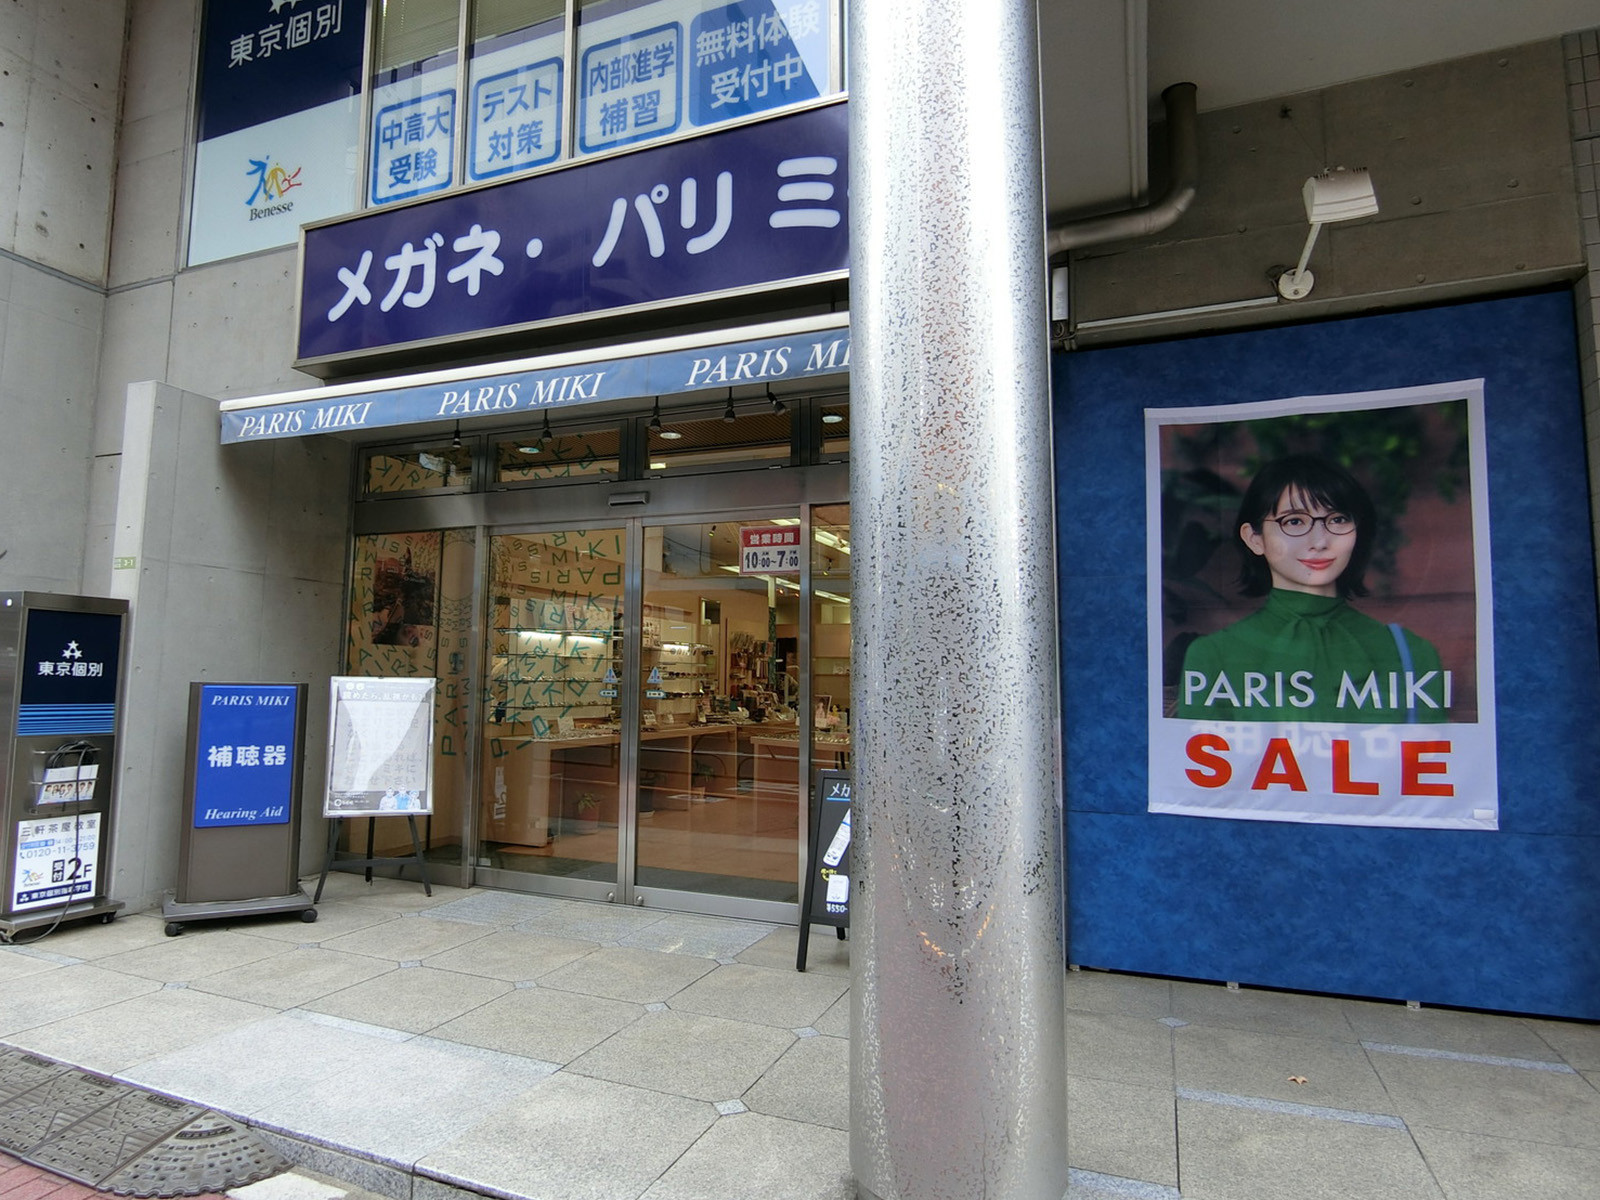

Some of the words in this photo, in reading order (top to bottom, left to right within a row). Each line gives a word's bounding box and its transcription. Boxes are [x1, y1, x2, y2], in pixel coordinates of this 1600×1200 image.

[228, 0, 342, 68] 東京個別
[696, 2, 820, 68] 無料体験
[589, 42, 675, 97] 内部進学
[711, 53, 802, 109] 受付中
[483, 79, 552, 123] テスト
[600, 90, 660, 137] 補習
[382, 105, 450, 150] 中高大
[488, 120, 543, 163] 対策
[388, 147, 437, 189] 受験
[249, 201, 294, 222] Benesse
[685, 345, 792, 387] PARIS
[436, 382, 520, 416] PARIS
[529, 372, 605, 406] MIKI
[238, 409, 305, 437] PARIS
[310, 401, 373, 430] MIKI
[552, 534, 621, 566] MIKI
[750, 532, 795, 545] 営業時間
[37, 661, 103, 677] 東京個別
[1184, 670, 1315, 708] PARIS
[1335, 669, 1452, 709] MIKI
[211, 695, 254, 706] PARIS
[255, 695, 290, 706] MIKI
[207, 745, 287, 768] 補聴器
[1184, 733, 1455, 797] SALE
[204, 808, 258, 820] Hearing
[260, 806, 284, 817] Aid
